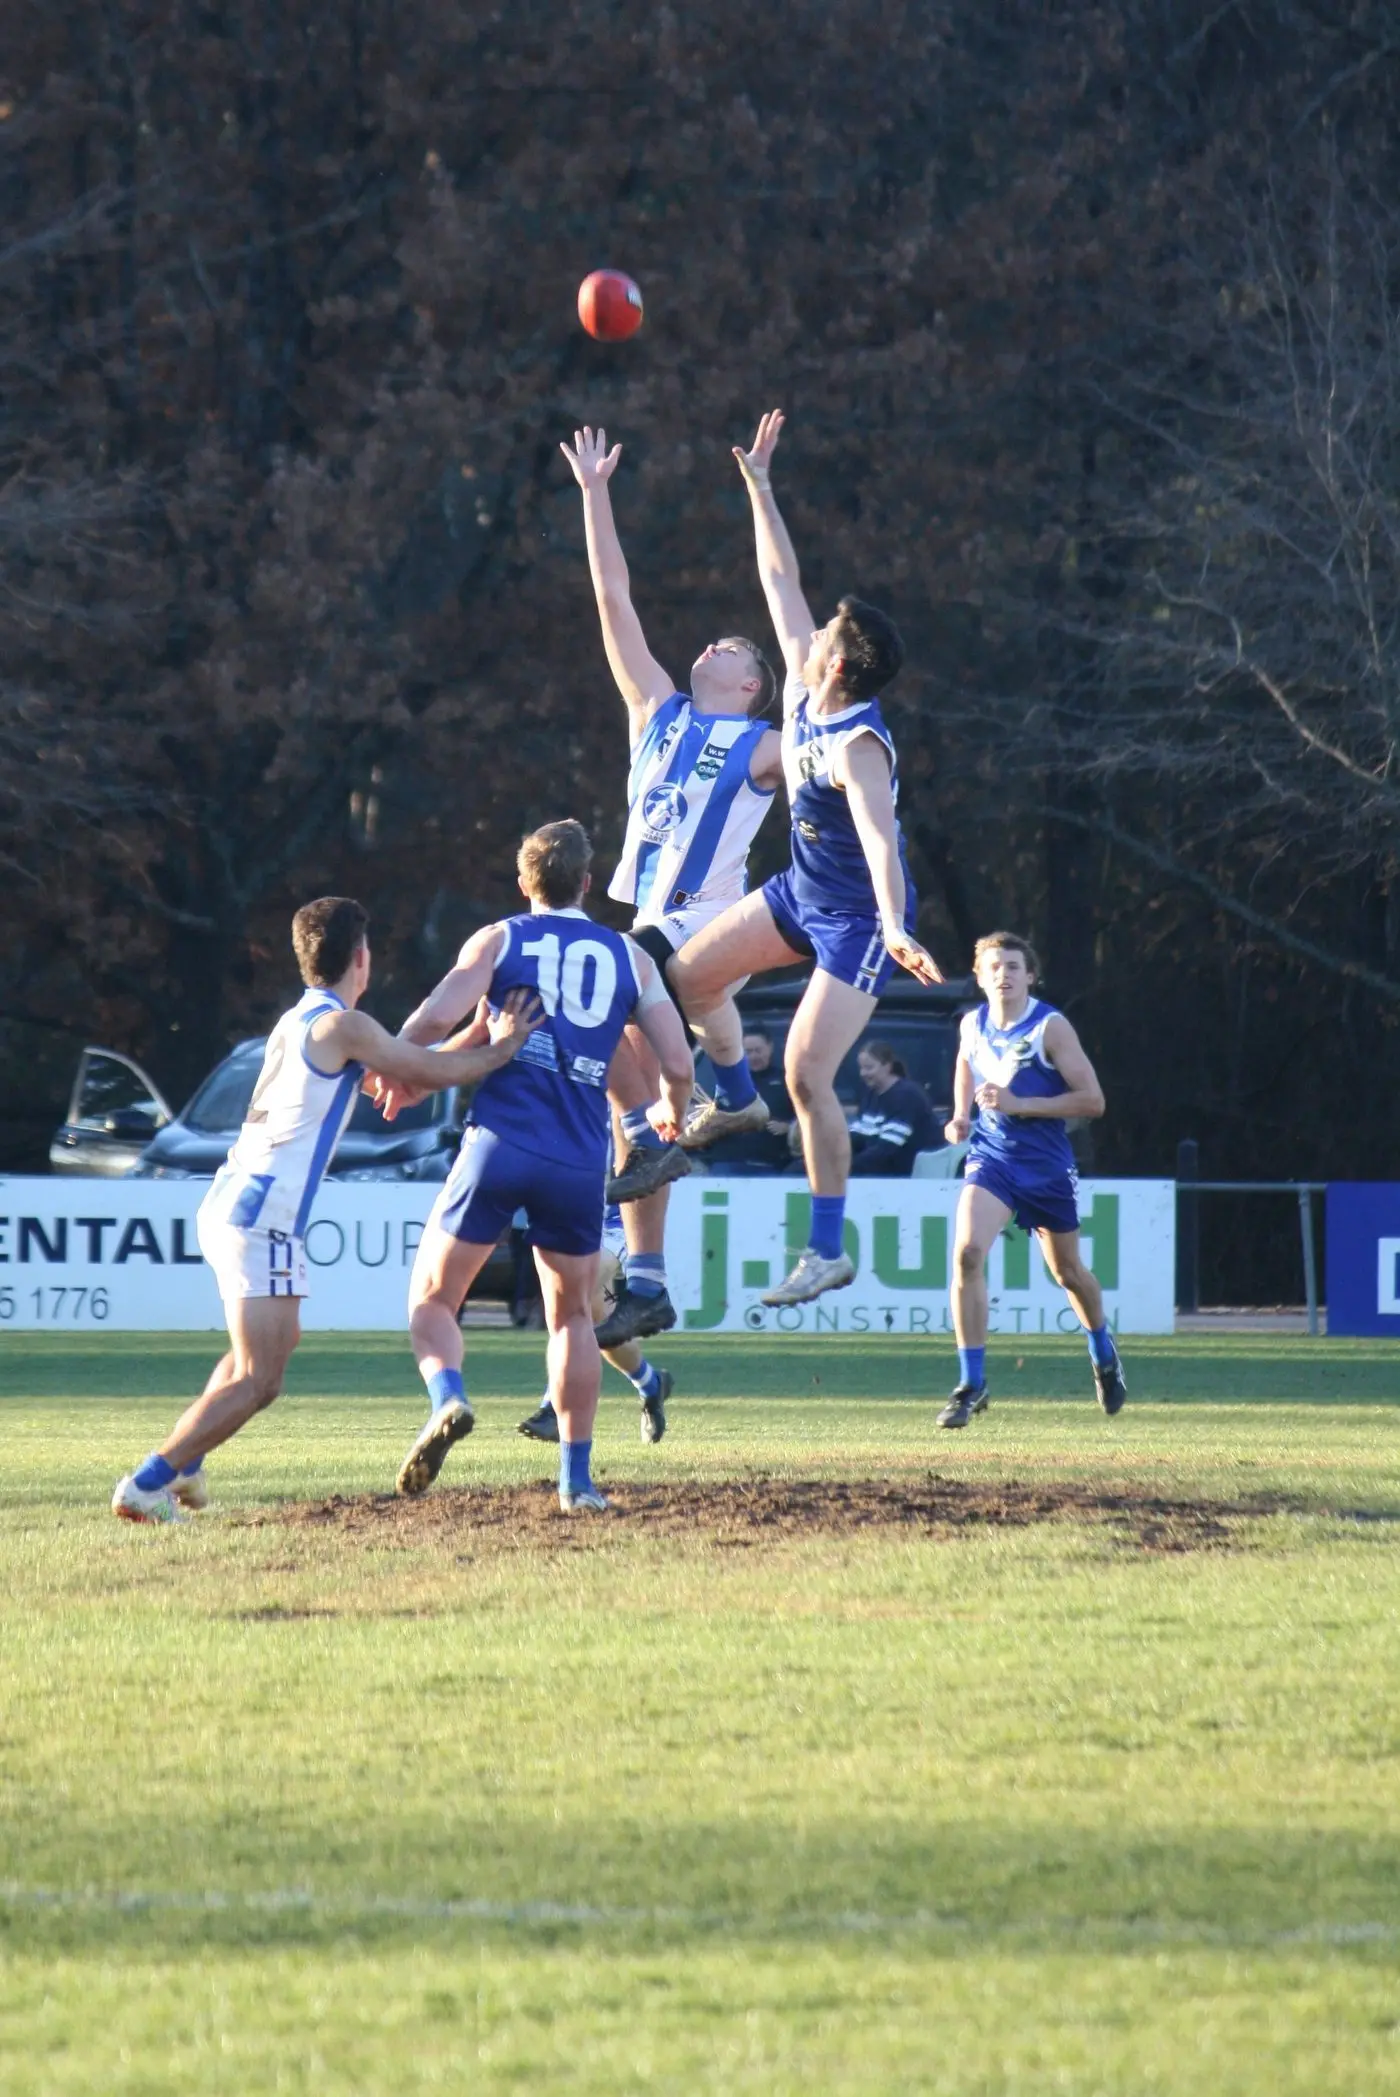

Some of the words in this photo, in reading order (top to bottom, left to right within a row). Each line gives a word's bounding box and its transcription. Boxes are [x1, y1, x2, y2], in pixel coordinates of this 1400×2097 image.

[521, 933, 617, 1028] 10
[0, 1217, 204, 1264] NTAL
[304, 1219, 426, 1267] OUP
[683, 1191, 1119, 1330] j.buld
[30, 1286, 109, 1320] 1776
